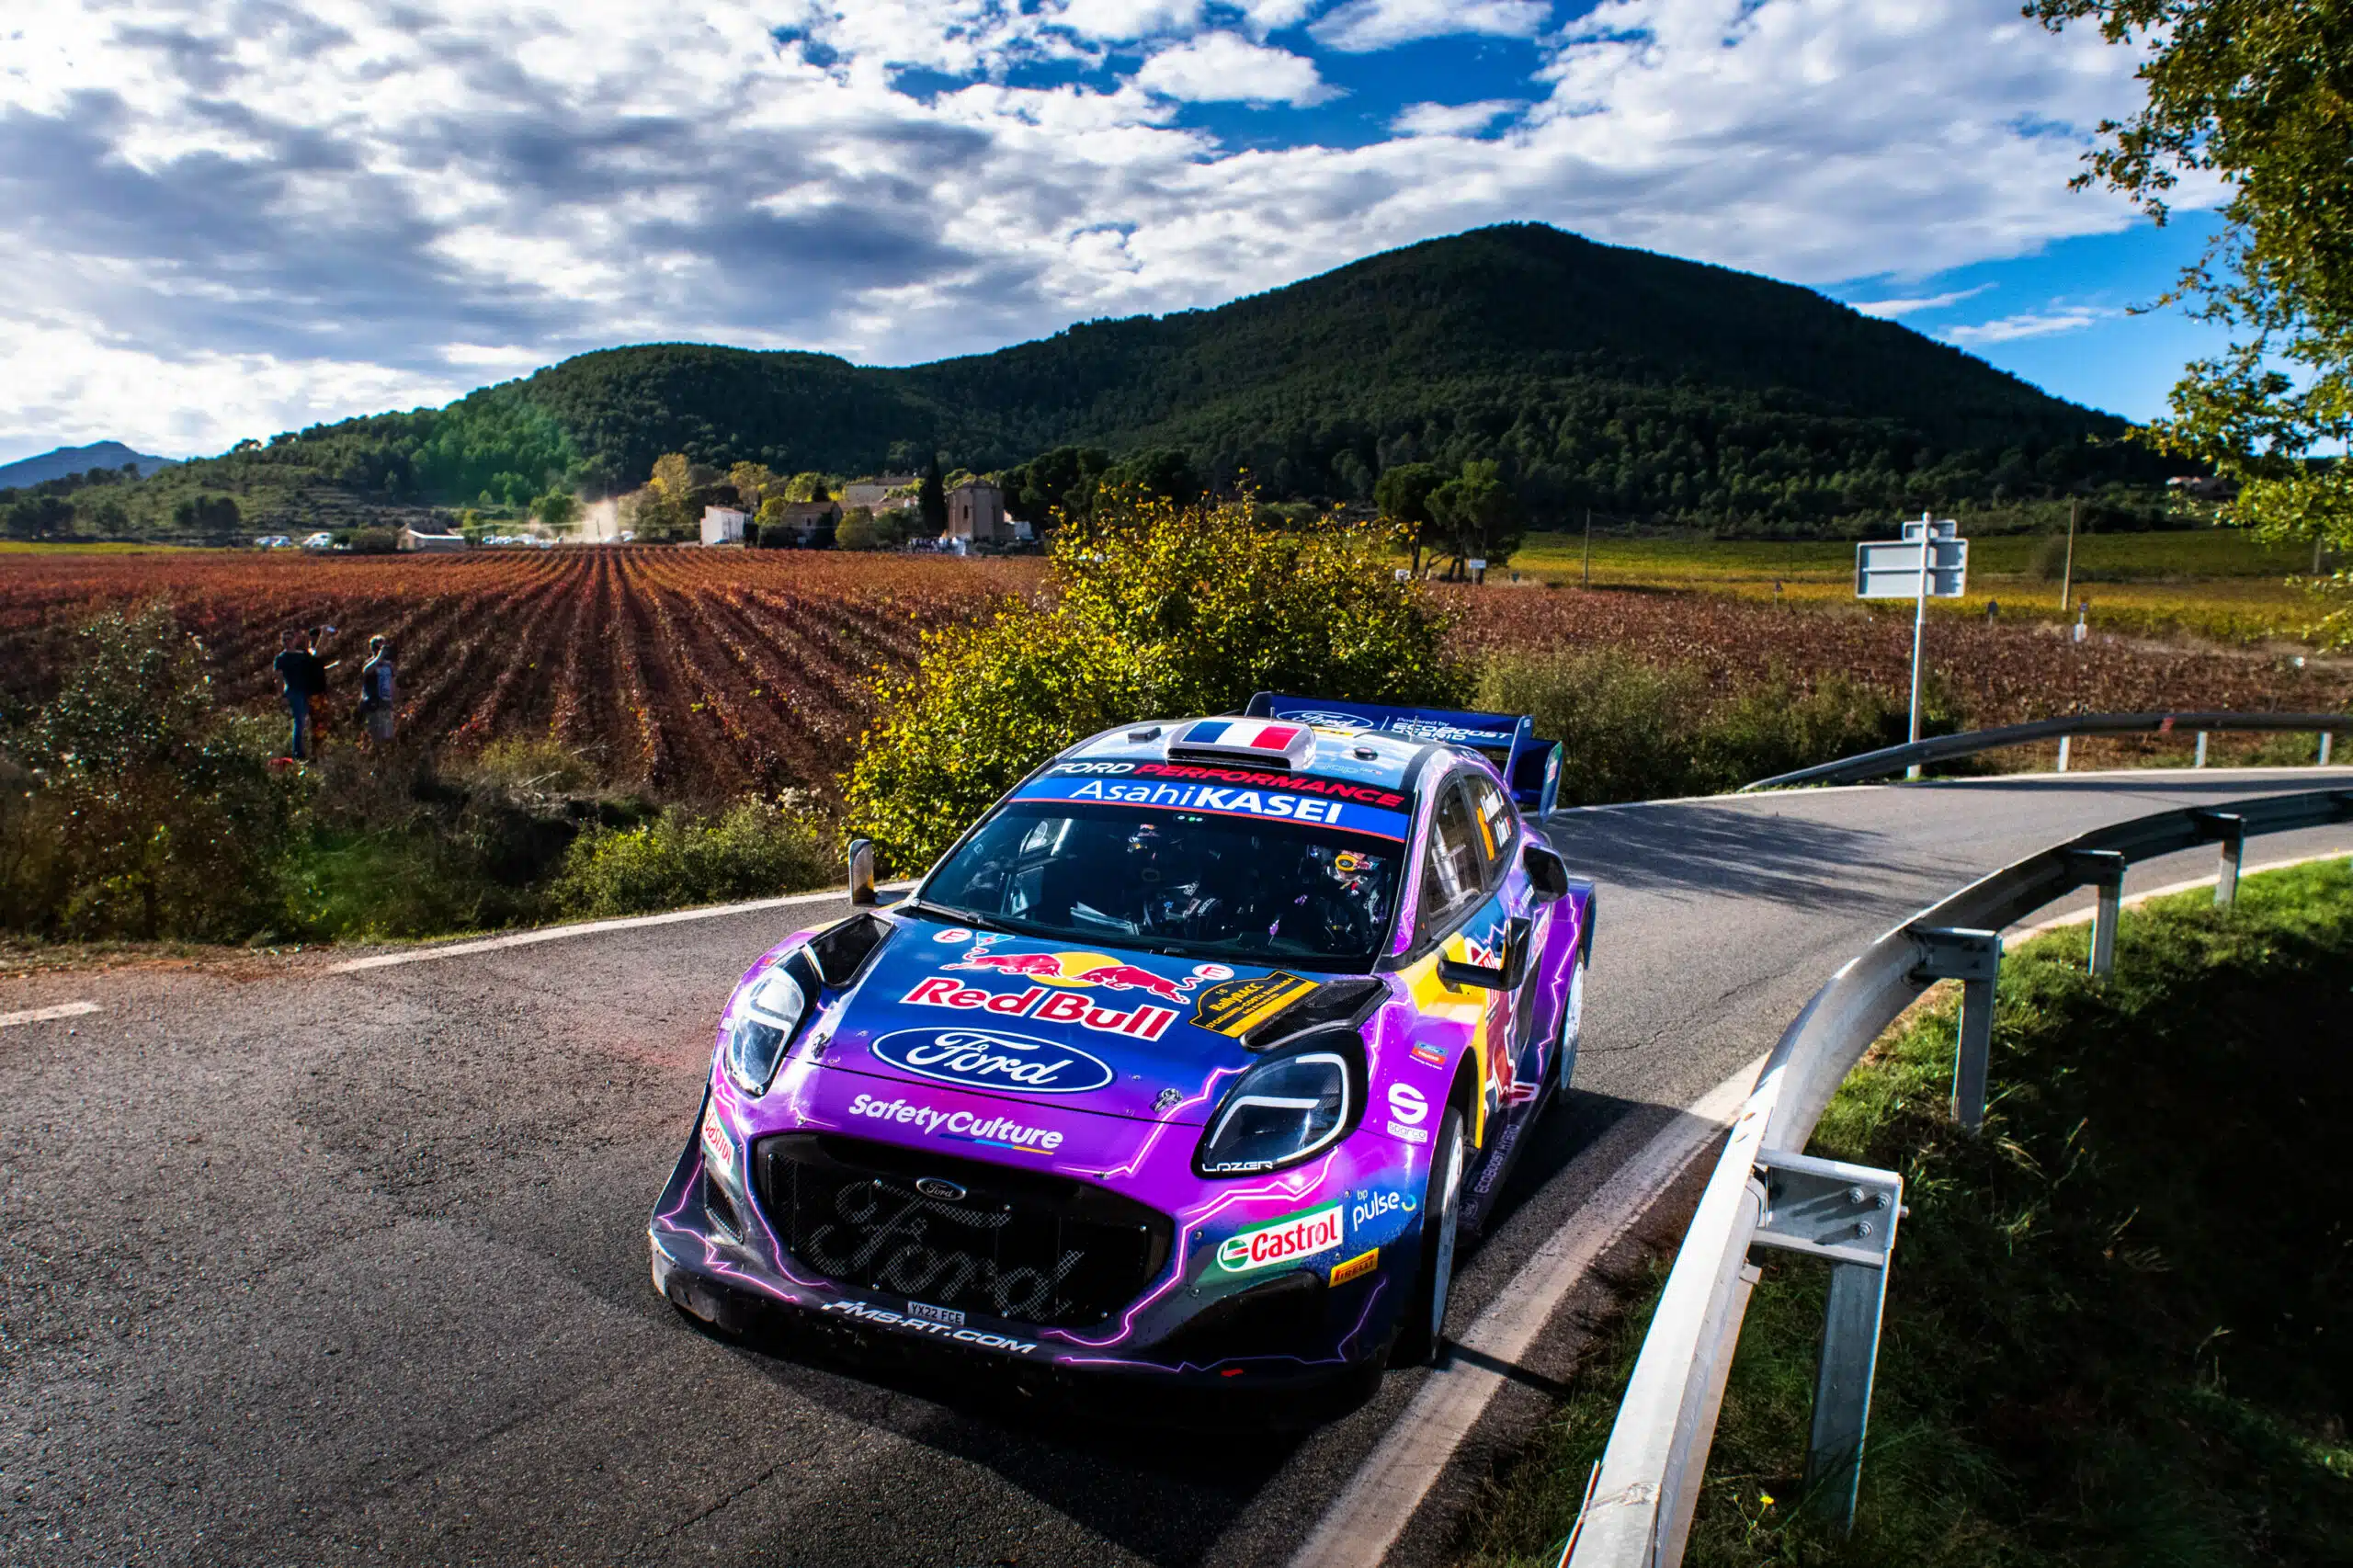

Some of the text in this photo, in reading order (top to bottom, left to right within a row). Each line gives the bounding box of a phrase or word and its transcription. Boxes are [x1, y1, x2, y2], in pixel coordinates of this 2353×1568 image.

[1299, 710, 1359, 728] Ford
[1392, 722, 1513, 739] ECOBOOST
[1397, 717, 1435, 726] Powered
[1048, 762, 1405, 808] FORD PERFORMANCE
[1068, 779, 1344, 824] AsahiKASEI
[905, 1032, 1075, 1085] Ford
[848, 1094, 1063, 1149] SafetyCulture
[1389, 1122, 1427, 1139] sparco
[926, 1183, 954, 1198] Ford
[1357, 1189, 1368, 1200] bp
[1352, 1192, 1400, 1232] pulse
[809, 1180, 1085, 1322] Ford
[1251, 1213, 1338, 1262] Castrol
[1334, 1254, 1374, 1282] PIRELLI
[912, 1304, 962, 1324] YX22 FCE
